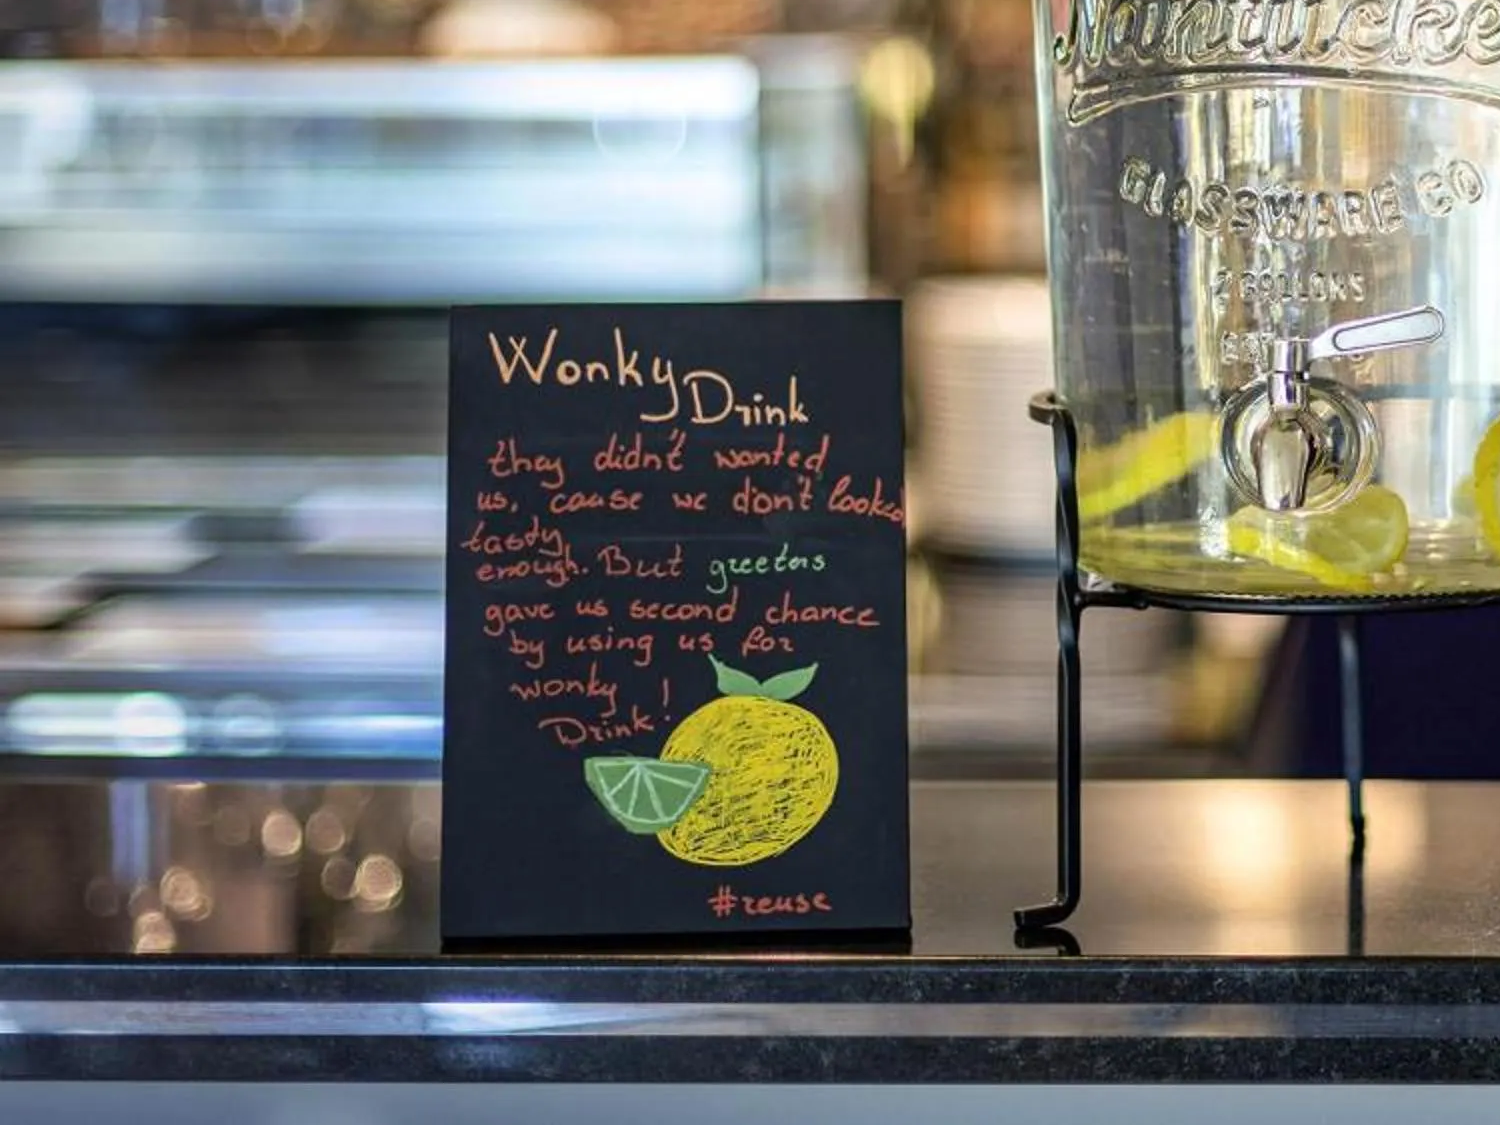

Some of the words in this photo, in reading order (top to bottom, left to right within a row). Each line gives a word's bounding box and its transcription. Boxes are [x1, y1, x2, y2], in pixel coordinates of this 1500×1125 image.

[1119, 154, 1403, 238] GLASSWARE
[488, 327, 679, 421] Wonky
[683, 371, 809, 425] Drink
[488, 438, 565, 489] they
[594, 428, 687, 472] didn't
[550, 488, 643, 514] cause
[672, 491, 708, 511] we
[732, 475, 813, 515] don't
[598, 544, 684, 578] But
[485, 600, 556, 636] gave
[576, 599, 609, 618] us
[629, 586, 739, 621] second
[765, 591, 880, 627] chance
[509, 635, 544, 669] by
[567, 628, 654, 667] using
[679, 633, 714, 653] us
[742, 627, 795, 658] for
[509, 660, 618, 718] wonky
[708, 886, 833, 918] #reuse
